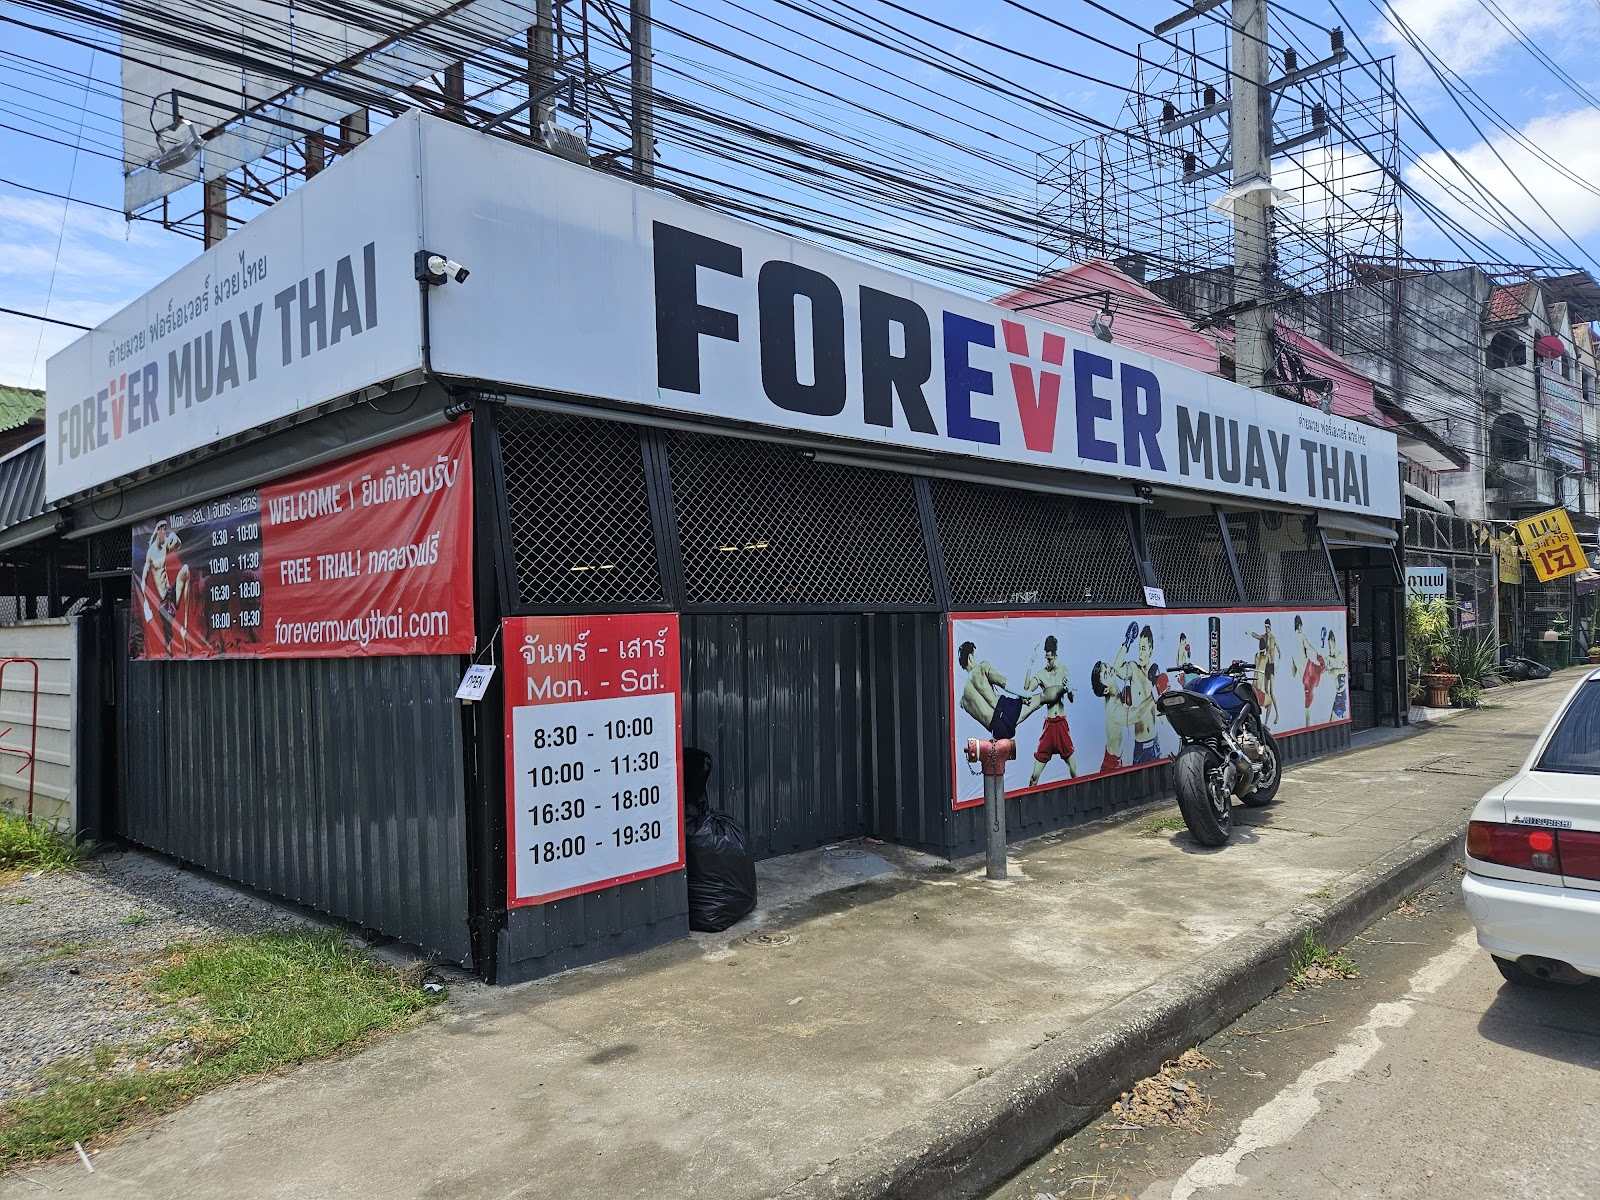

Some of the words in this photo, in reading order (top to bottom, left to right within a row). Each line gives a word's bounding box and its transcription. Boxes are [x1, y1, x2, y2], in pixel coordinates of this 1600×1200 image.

[108, 329, 146, 368] ค่ายมวย
[150, 274, 211, 343] ฟอร์เอเวอร์
[214, 250, 267, 306] มวยไทย
[58, 361, 160, 466] FOREVER
[168, 302, 263, 416] MUAY
[274, 241, 378, 367] THAI
[652, 220, 1168, 472] FOREVER
[1176, 404, 1290, 493] MUAY
[1300, 438, 1370, 507] THAI
[269, 484, 342, 526] WELCOME
[362, 454, 458, 507] ยินดีต้อนรับ
[192, 508, 206, 524] Sat.
[212, 529, 228, 546] 8:30
[237, 523, 258, 542] 10:00
[209, 557, 228, 574] 10:00
[238, 552, 259, 570] 11:30
[280, 558, 312, 585] FREE
[317, 550, 360, 580] TRIAL!
[368, 531, 440, 574] ทดลองฟรี
[1538, 544, 1576, 574] เจ
[210, 584, 230, 601] 16:30
[239, 581, 260, 598] 18:00
[1408, 573, 1444, 586] กาแฟ
[1149, 592, 1160, 600] OPEN
[211, 612, 230, 628] 18:00
[240, 610, 260, 626] 19:30
[275, 608, 449, 648] forevermuaythai.com
[519, 630, 591, 664] จันทร์
[619, 627, 668, 660] เสาร์
[466, 675, 485, 688] OPEN
[527, 676, 588, 700] Mon.
[620, 668, 664, 692] Sat.
[534, 725, 578, 749] 8:30
[604, 716, 653, 740] 10:00
[528, 762, 584, 788] 10:00
[610, 751, 659, 775] 11:30
[528, 798, 585, 826] 16:30
[612, 786, 660, 812] 18:00
[1522, 816, 1572, 828] MITSUBISHI
[529, 836, 586, 864] 18:00
[612, 820, 661, 848] 19:30
